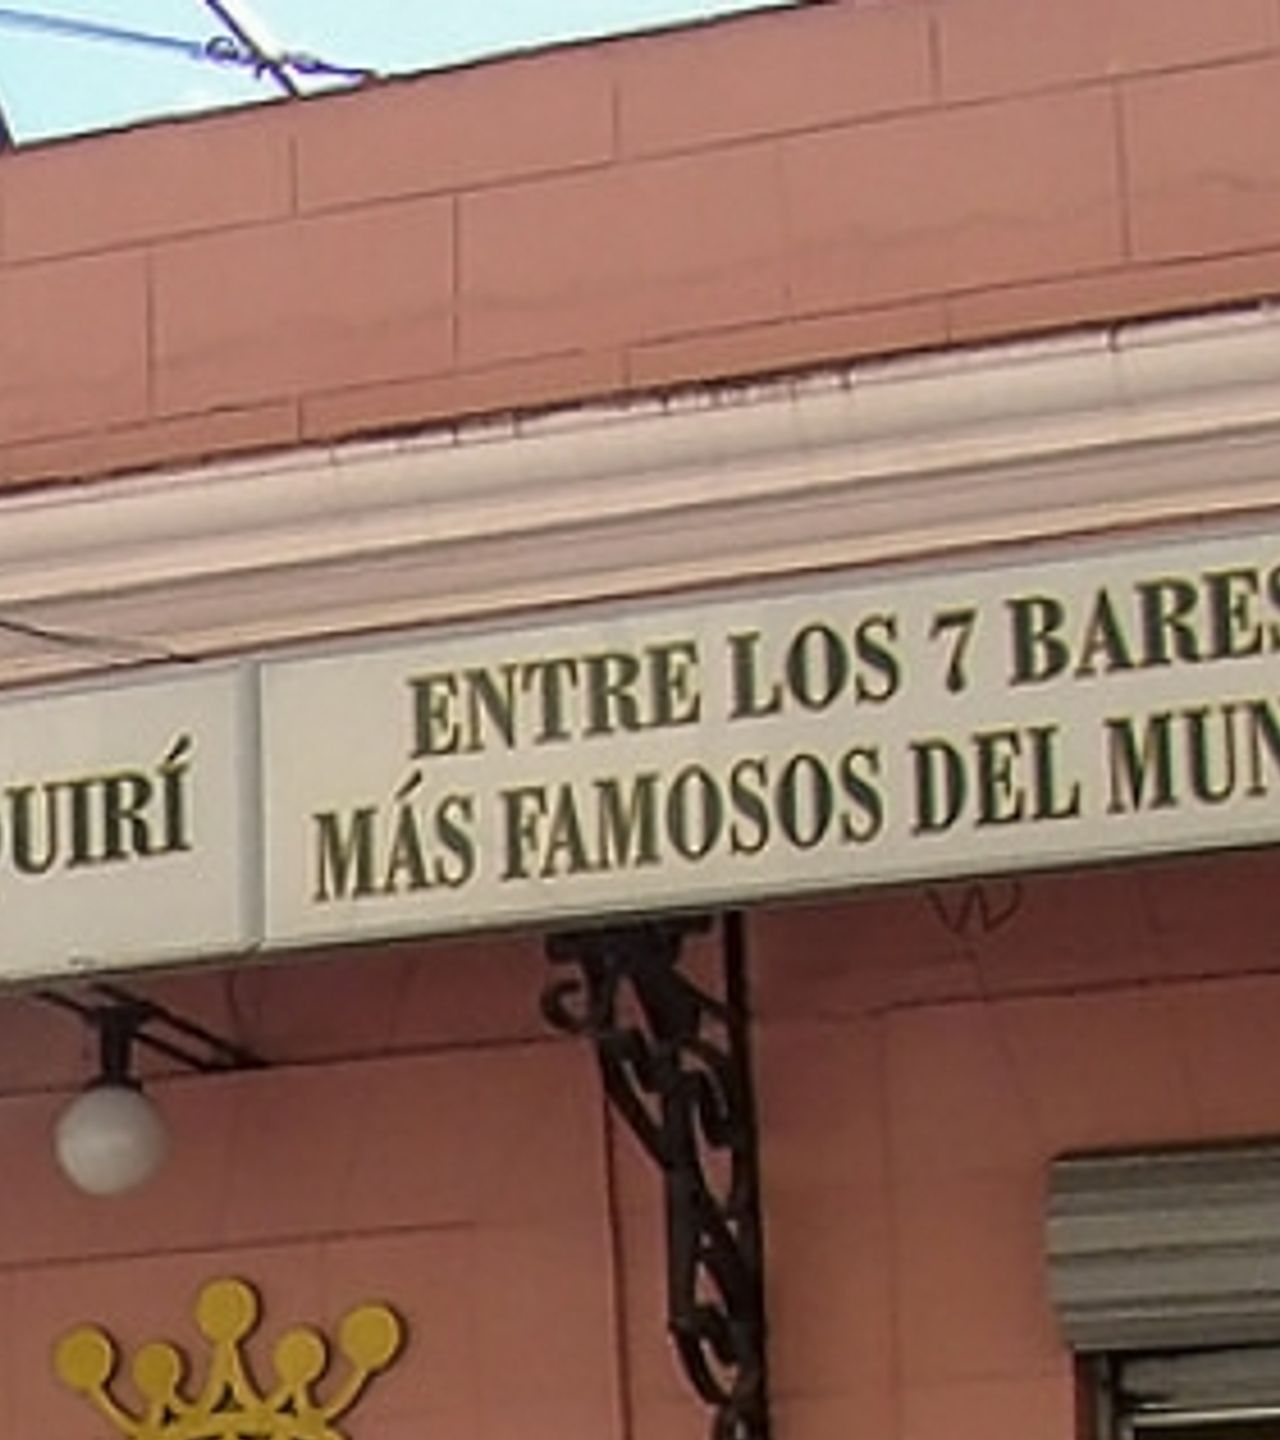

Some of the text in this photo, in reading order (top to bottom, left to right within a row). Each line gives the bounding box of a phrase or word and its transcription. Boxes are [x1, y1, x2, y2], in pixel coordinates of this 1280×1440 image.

[406, 639, 702, 760] ENTRE
[726, 613, 901, 721] LOS
[929, 607, 978, 694] 7
[311, 769, 477, 902] MÁS
[498, 745, 884, 882] FAMOSOS
[907, 723, 1082, 837] DEL
